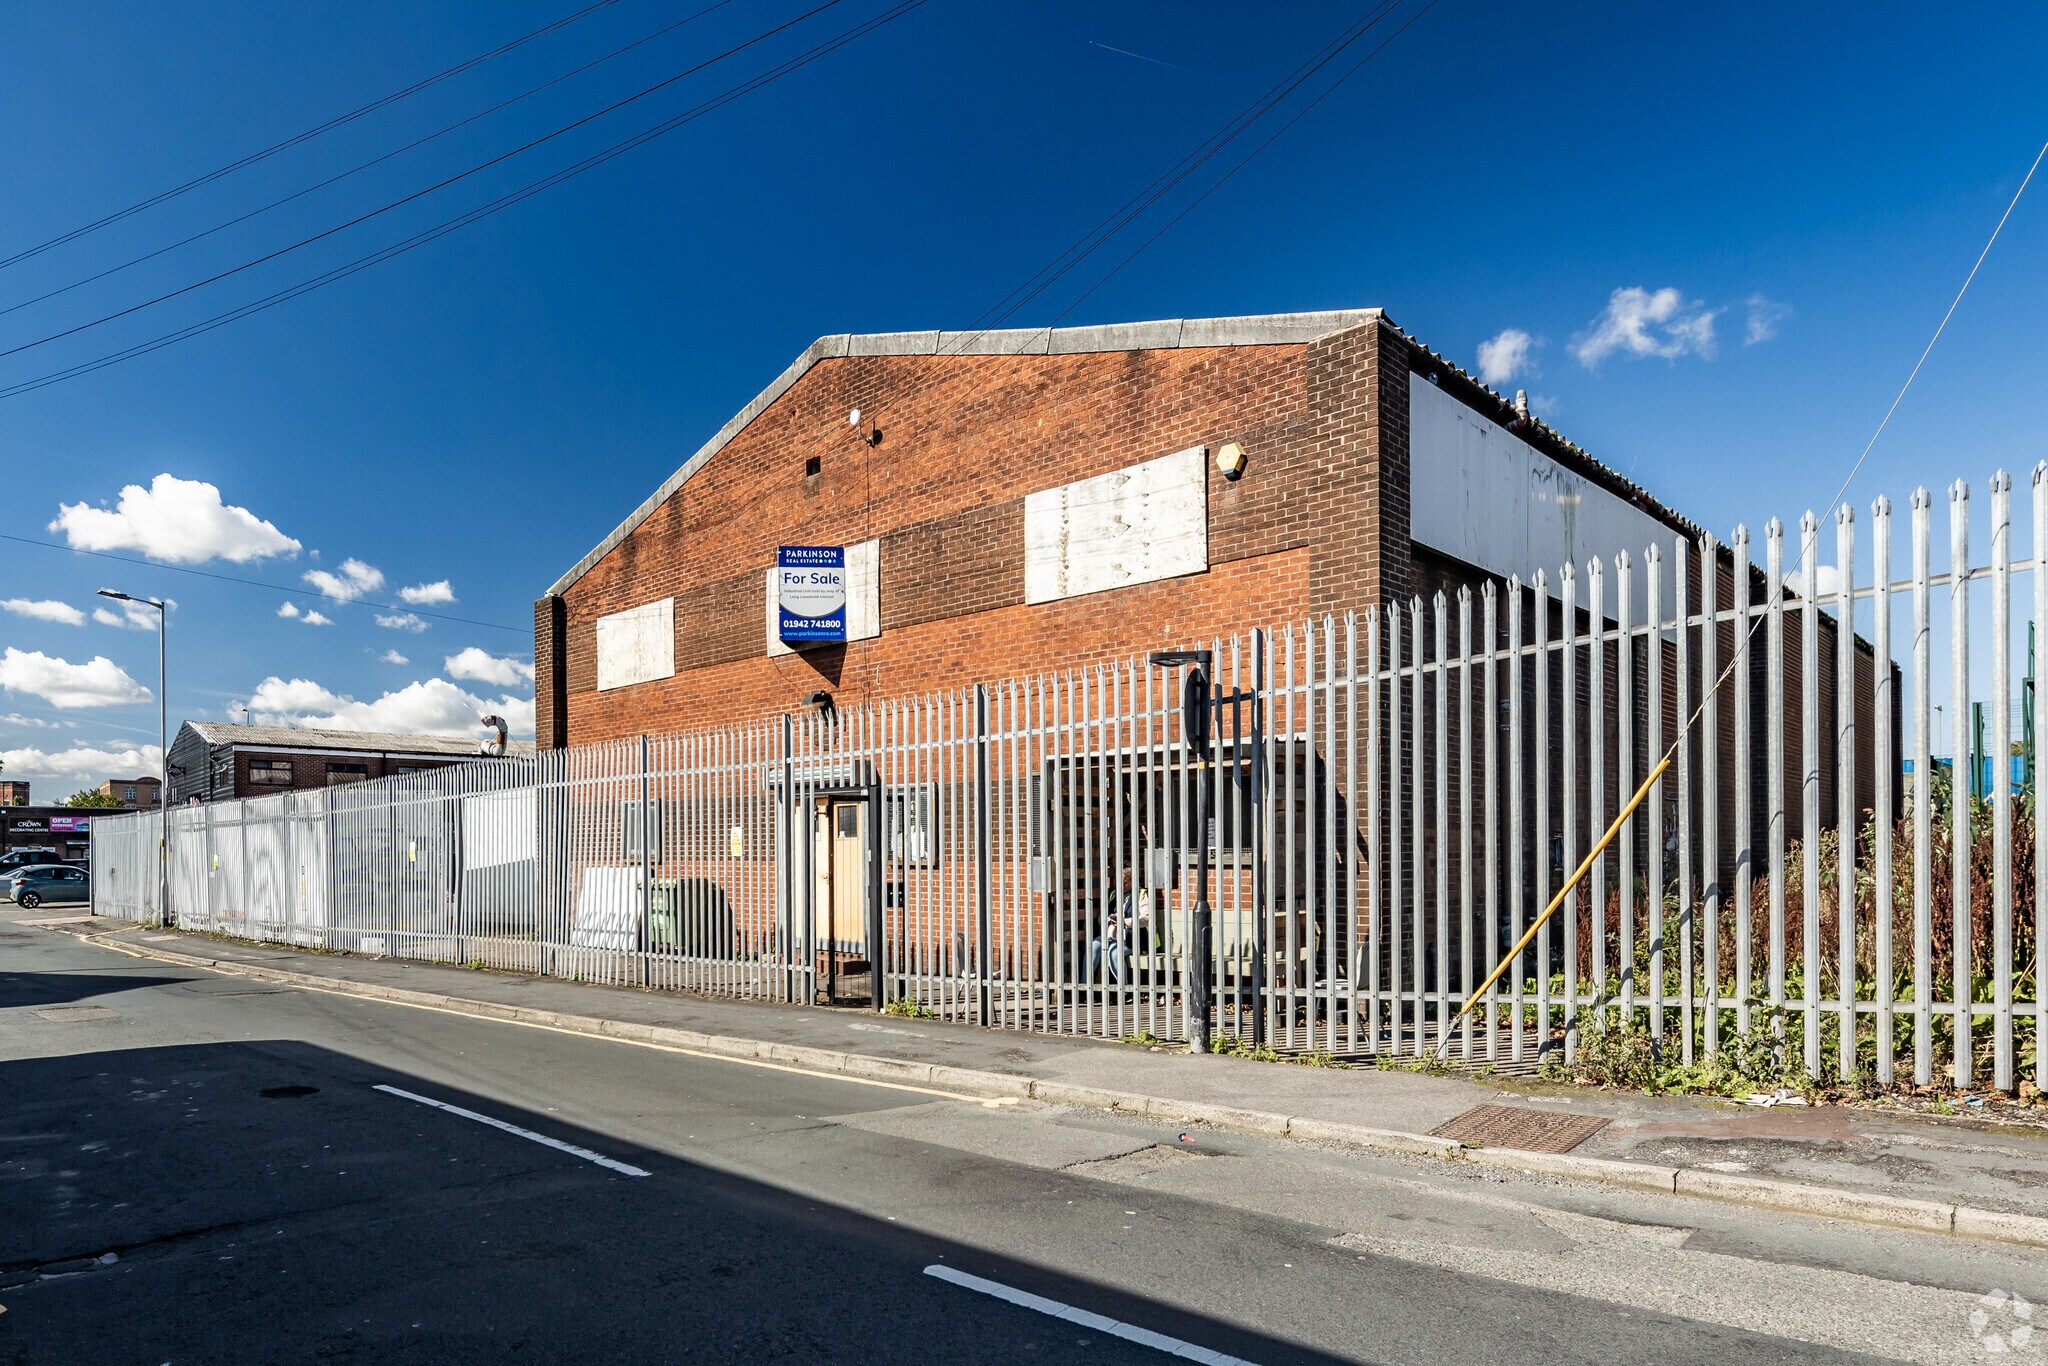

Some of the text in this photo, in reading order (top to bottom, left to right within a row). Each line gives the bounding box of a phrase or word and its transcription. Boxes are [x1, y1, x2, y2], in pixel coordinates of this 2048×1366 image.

[786, 550, 837, 558] PARKINSON
[784, 572, 840, 584] For Sale
[783, 620, 841, 628] 01942 741800
